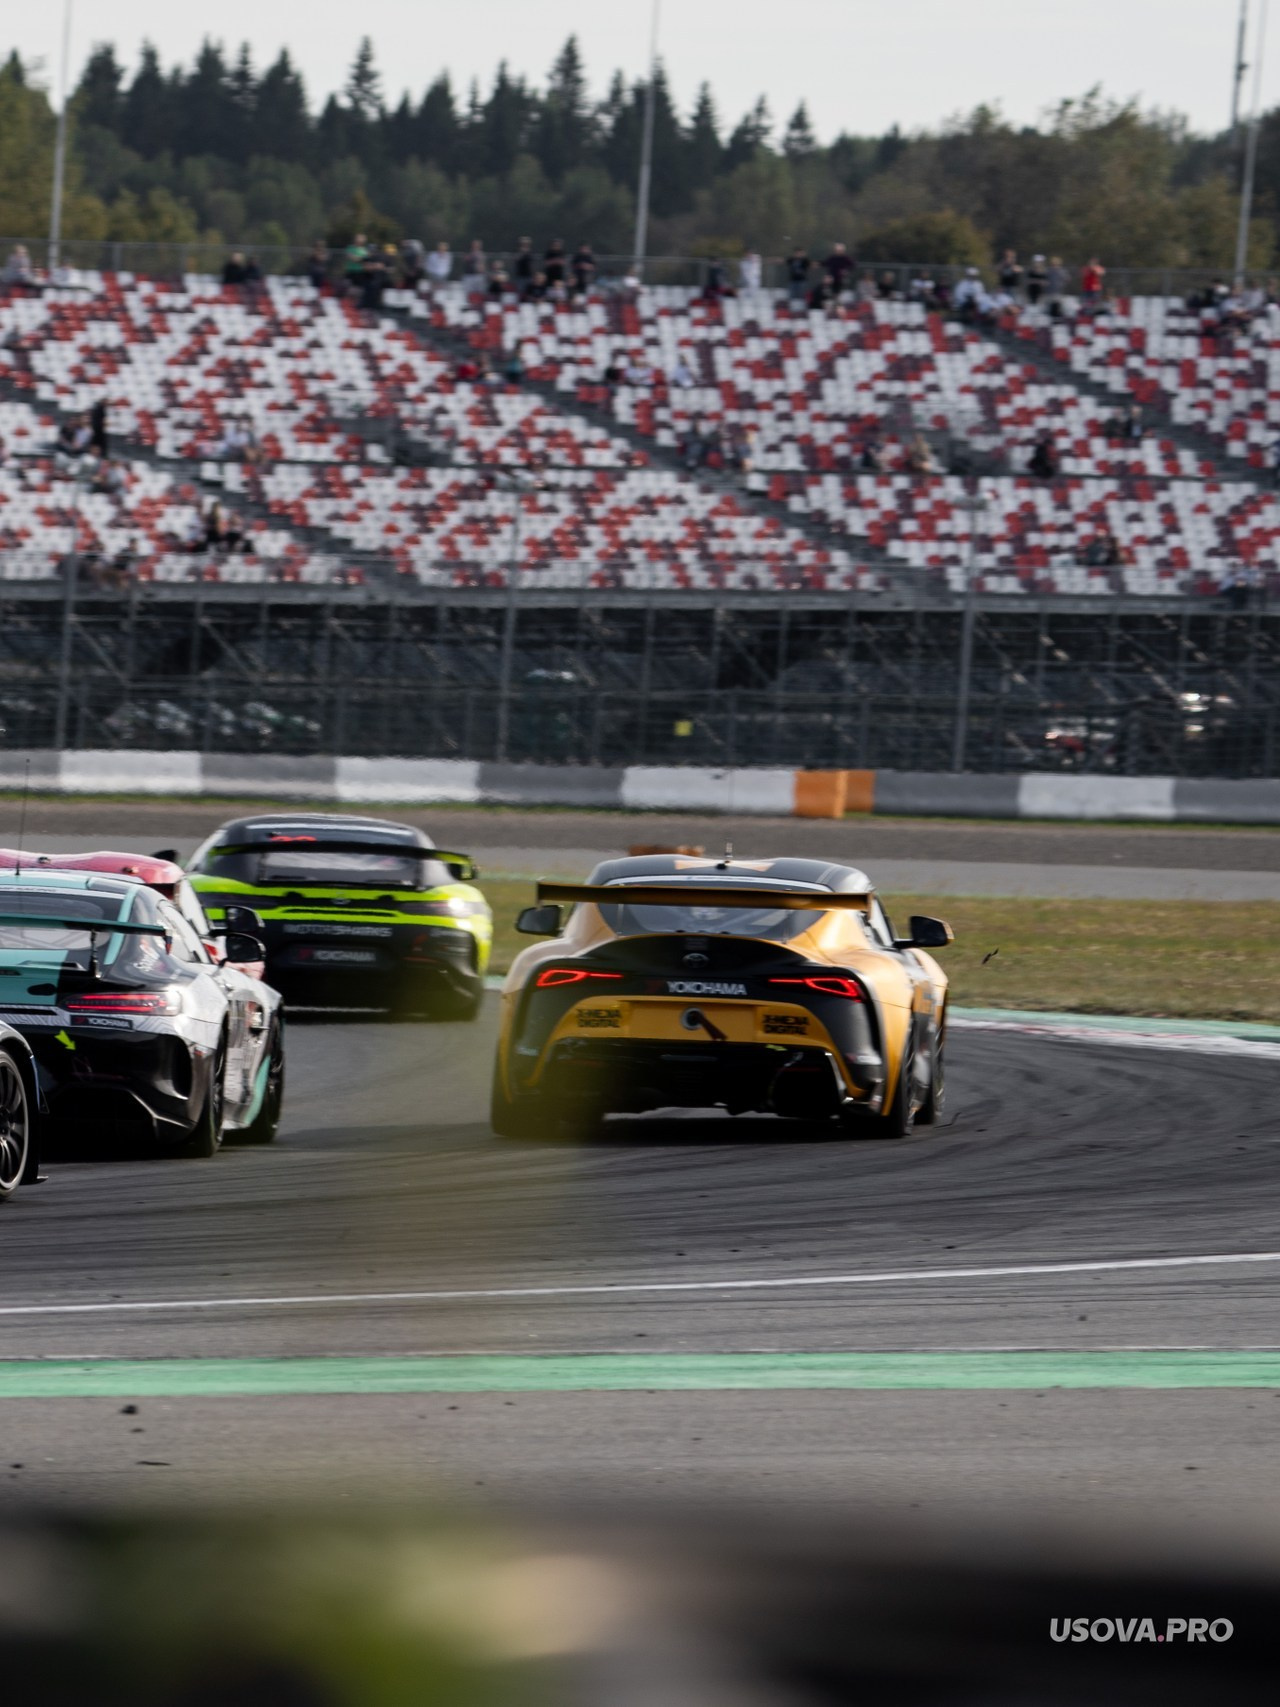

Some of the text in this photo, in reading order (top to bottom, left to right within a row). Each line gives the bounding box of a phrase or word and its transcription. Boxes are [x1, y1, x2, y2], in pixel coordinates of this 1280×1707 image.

[667, 981, 748, 995] YOKOHAMA
[578, 1018, 621, 1028] DIGITAL
[764, 1024, 808, 1035] DIGITAL
